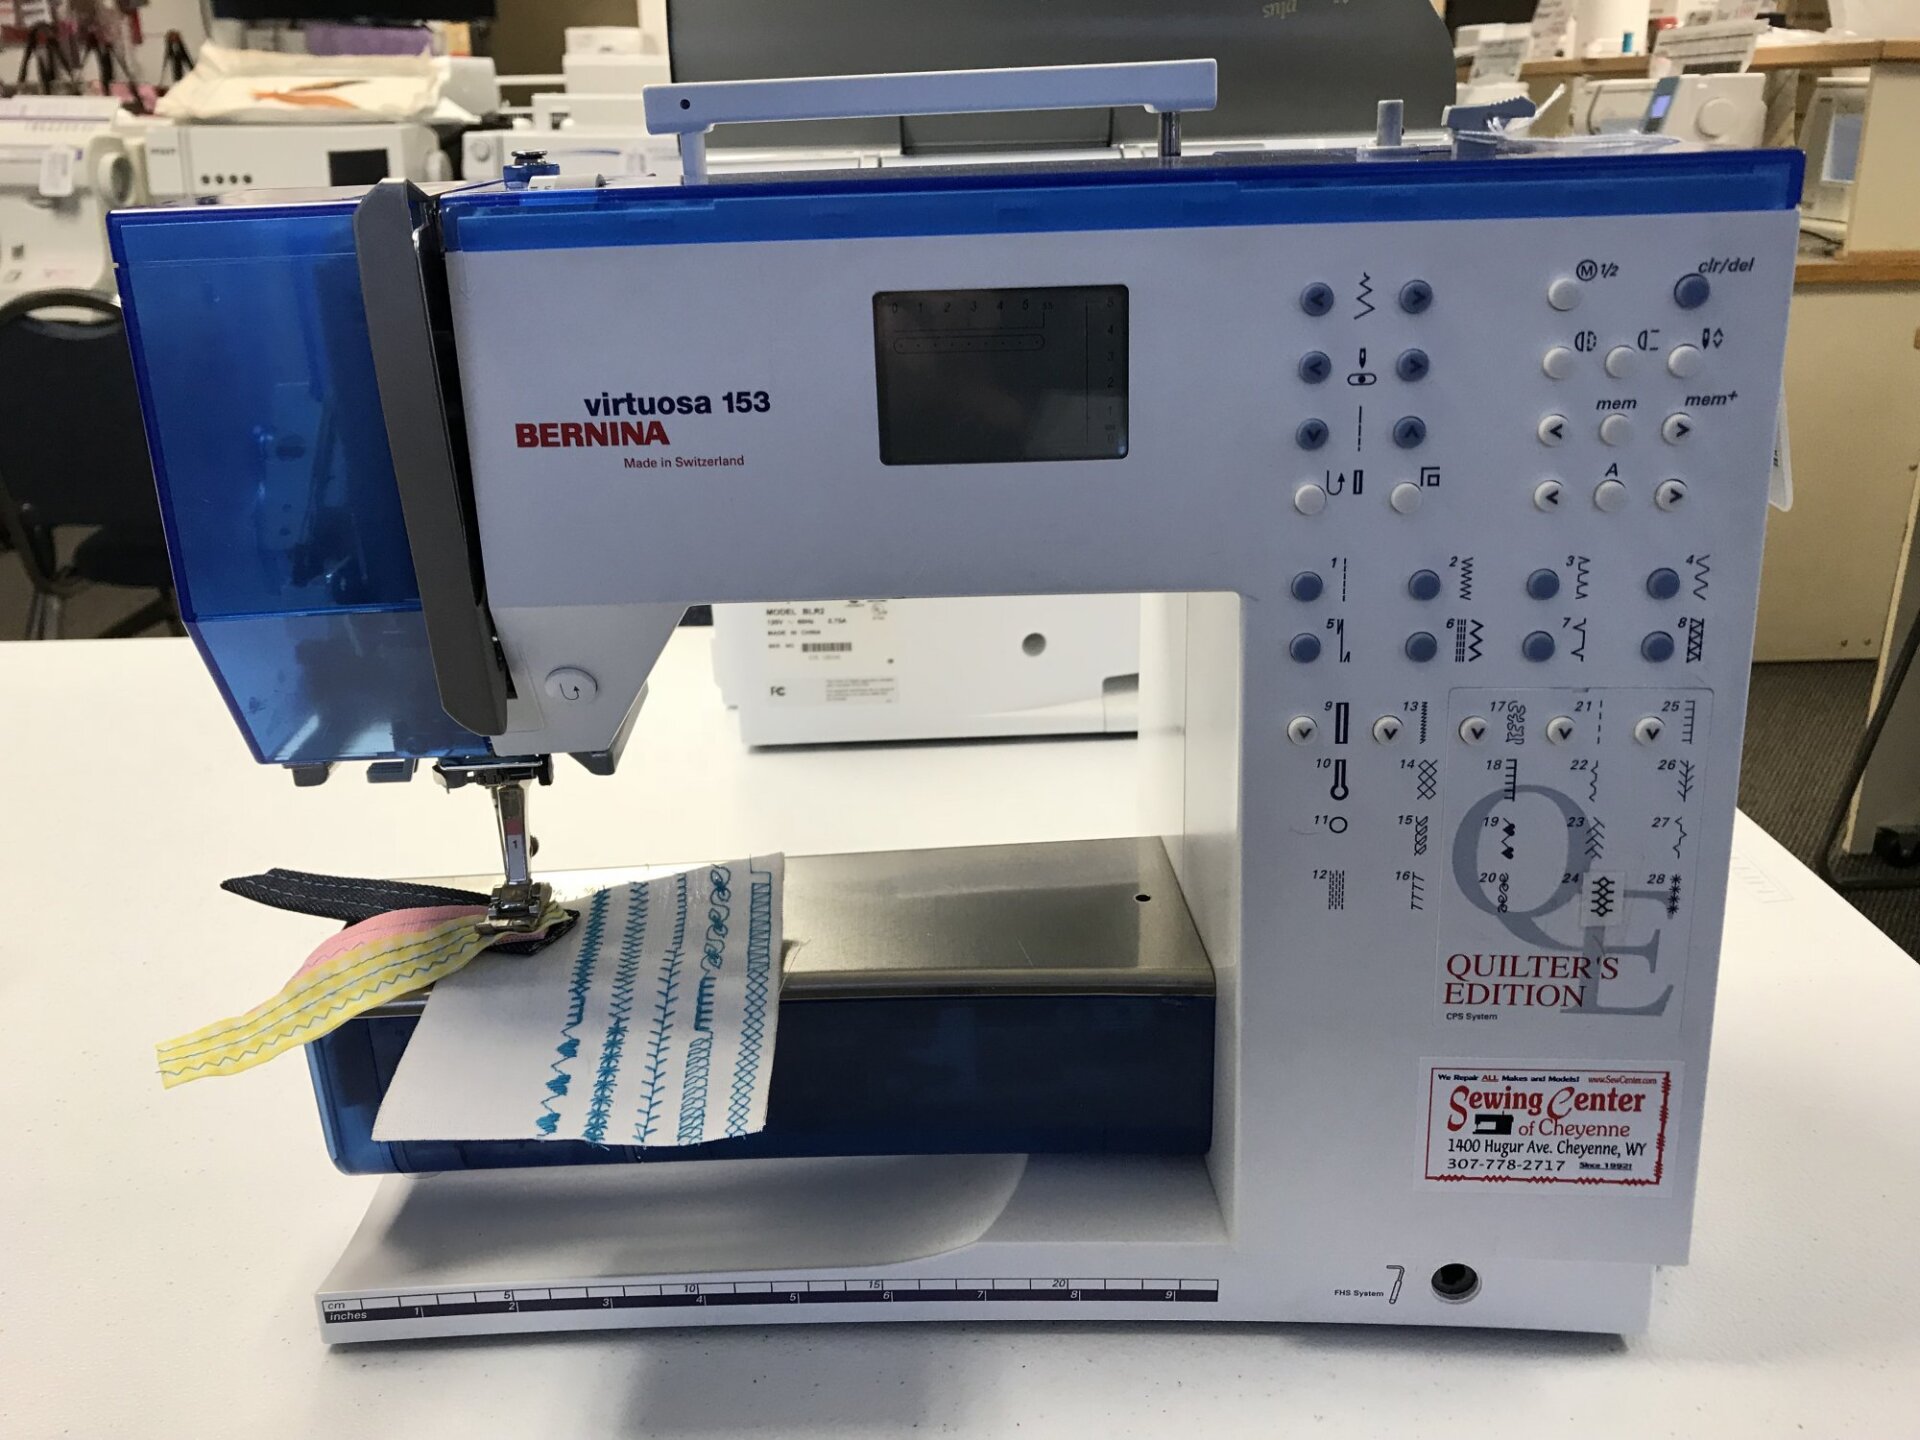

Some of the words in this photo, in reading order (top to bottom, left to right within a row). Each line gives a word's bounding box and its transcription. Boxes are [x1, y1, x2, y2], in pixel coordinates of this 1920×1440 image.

[1600, 262, 1619, 278] 1/2
[1698, 257, 1755, 274] clr/del
[584, 391, 712, 417] virtuosa
[722, 390, 771, 413] 153
[1596, 398, 1637, 411] mem
[1684, 391, 1738, 407] mem+
[515, 420, 670, 448] BERNINA
[624, 457, 657, 469] Made
[661, 456, 672, 468] in
[676, 454, 745, 468] Switzerland
[1605, 462, 1618, 477] A
[1330, 557, 1337, 569] 1
[1449, 556, 1458, 568] 2
[1566, 555, 1575, 567] 3
[1686, 554, 1694, 565] 4
[1326, 618, 1335, 629] 5
[1446, 618, 1455, 629] 6
[1562, 617, 1571, 628] 7
[1678, 617, 1687, 628] 8
[1324, 701, 1333, 711] 9
[1403, 701, 1419, 712] 13
[1489, 701, 1506, 712] 17
[1574, 701, 1592, 712] 21
[1661, 701, 1680, 712] 25
[1316, 758, 1331, 769] 10
[1400, 759, 1415, 769] 14
[1486, 760, 1502, 771] 18
[1570, 760, 1588, 771] 22
[1657, 760, 1676, 771] 26
[1314, 815, 1329, 825] 11
[1398, 815, 1413, 825] 15
[1483, 817, 1499, 828] 19
[1567, 817, 1585, 828] 23
[1651, 817, 1670, 828] 27
[1312, 869, 1327, 880] 12
[1395, 871, 1410, 881] 16
[1479, 872, 1496, 884] 20
[1562, 873, 1579, 884] 24
[1647, 874, 1665, 884] 28
[1446, 954, 1619, 982] QUILTER'S
[1443, 982, 1588, 1008] EDITION
[1446, 1012, 1464, 1021] CPS
[1466, 1012, 1498, 1022] System
[1438, 1073, 1451, 1081] We
[1453, 1074, 1479, 1082] Repair
[1481, 1074, 1499, 1082] ALL
[1588, 1075, 1657, 1085] www.SewCenter.com
[1447, 1085, 1543, 1132] Sewing
[1547, 1086, 1646, 1120] Center
[1519, 1120, 1535, 1136] of
[1538, 1117, 1630, 1140] Cheyenne
[1448, 1138, 1480, 1152] 1400
[1484, 1139, 1524, 1158] Hugur
[1526, 1140, 1553, 1154] Ave.
[1557, 1138, 1621, 1159] Cheyenne,
[1625, 1141, 1647, 1156] WY
[1447, 1158, 1566, 1171] 307-778-2717
[1579, 1162, 1600, 1170] Since
[327, 1302, 346, 1311] cm
[503, 1290, 511, 1300] 5
[683, 1284, 696, 1294] 10
[869, 1280, 880, 1290] 15
[1052, 1278, 1066, 1288] 20
[1334, 1289, 1351, 1297] FHS
[1354, 1289, 1384, 1298] System
[329, 1310, 367, 1321] inches
[508, 1302, 515, 1311] 2
[602, 1298, 609, 1307] 3
[695, 1295, 703, 1304] 4
[789, 1293, 797, 1301] 5
[883, 1291, 890, 1300] 6
[977, 1290, 984, 1299] 7
[1070, 1290, 1078, 1299] 8
[1165, 1290, 1172, 1299] 9
